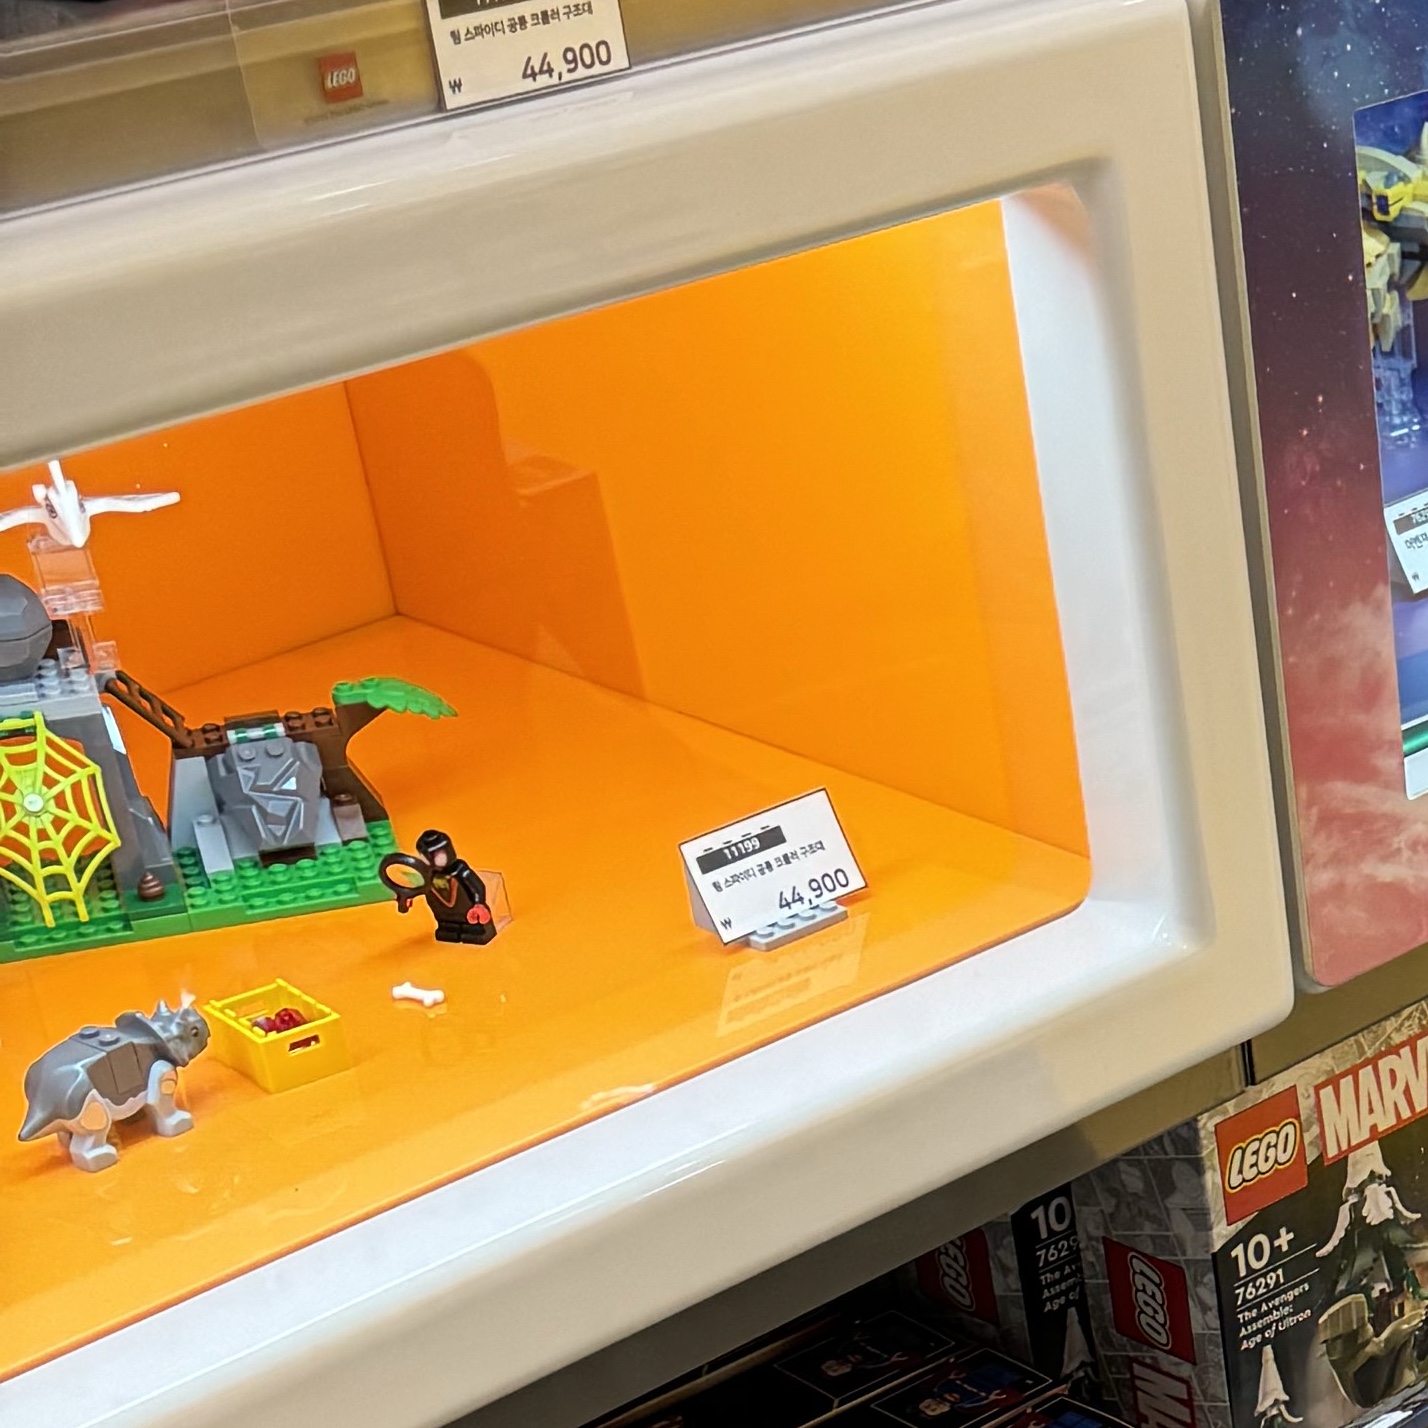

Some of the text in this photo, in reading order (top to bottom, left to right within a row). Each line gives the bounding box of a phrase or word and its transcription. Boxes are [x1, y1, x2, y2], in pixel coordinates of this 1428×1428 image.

[449, 1, 594, 45] 팀 스파이디 공룡 크롤러 구조대
[325, 66, 357, 90] LEGO
[521, 39, 612, 84] 44,900
[723, 837, 761, 861] 11199
[724, 868, 757, 889] 스파이디
[778, 867, 850, 911] 44,900
[1227, 1120, 1298, 1192] LEGO
[1230, 1225, 1295, 1279] 10+
[1129, 1250, 1170, 1350] LEGO
[1233, 1267, 1287, 1306] 76291
[1237, 1282, 1311, 1324] The Avengers
[1239, 1304, 1295, 1338] Assemble:
[1240, 1307, 1313, 1352] Age of Ultron
